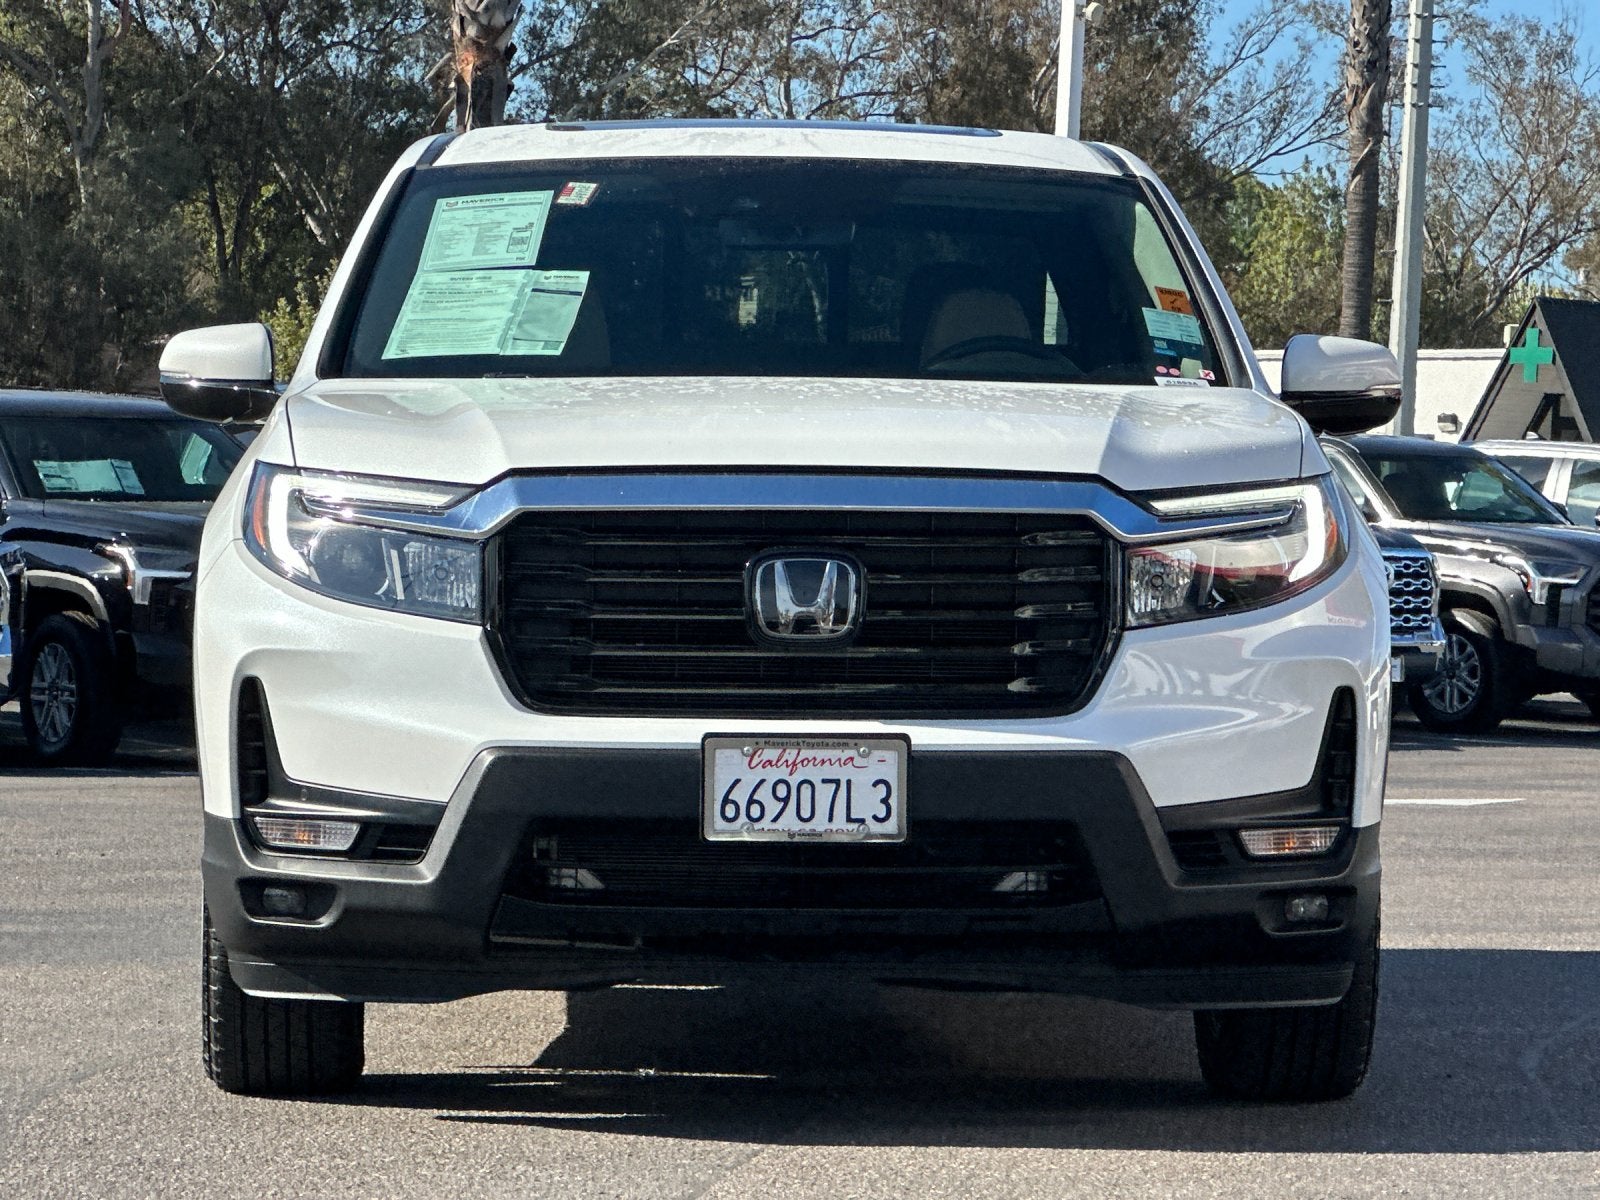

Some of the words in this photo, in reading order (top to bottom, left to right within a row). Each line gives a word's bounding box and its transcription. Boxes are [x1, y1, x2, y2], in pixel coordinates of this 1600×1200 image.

[763, 740, 850, 748] MaverickToyota.com
[747, 747, 869, 776] California
[719, 778, 893, 823] 66907L3
